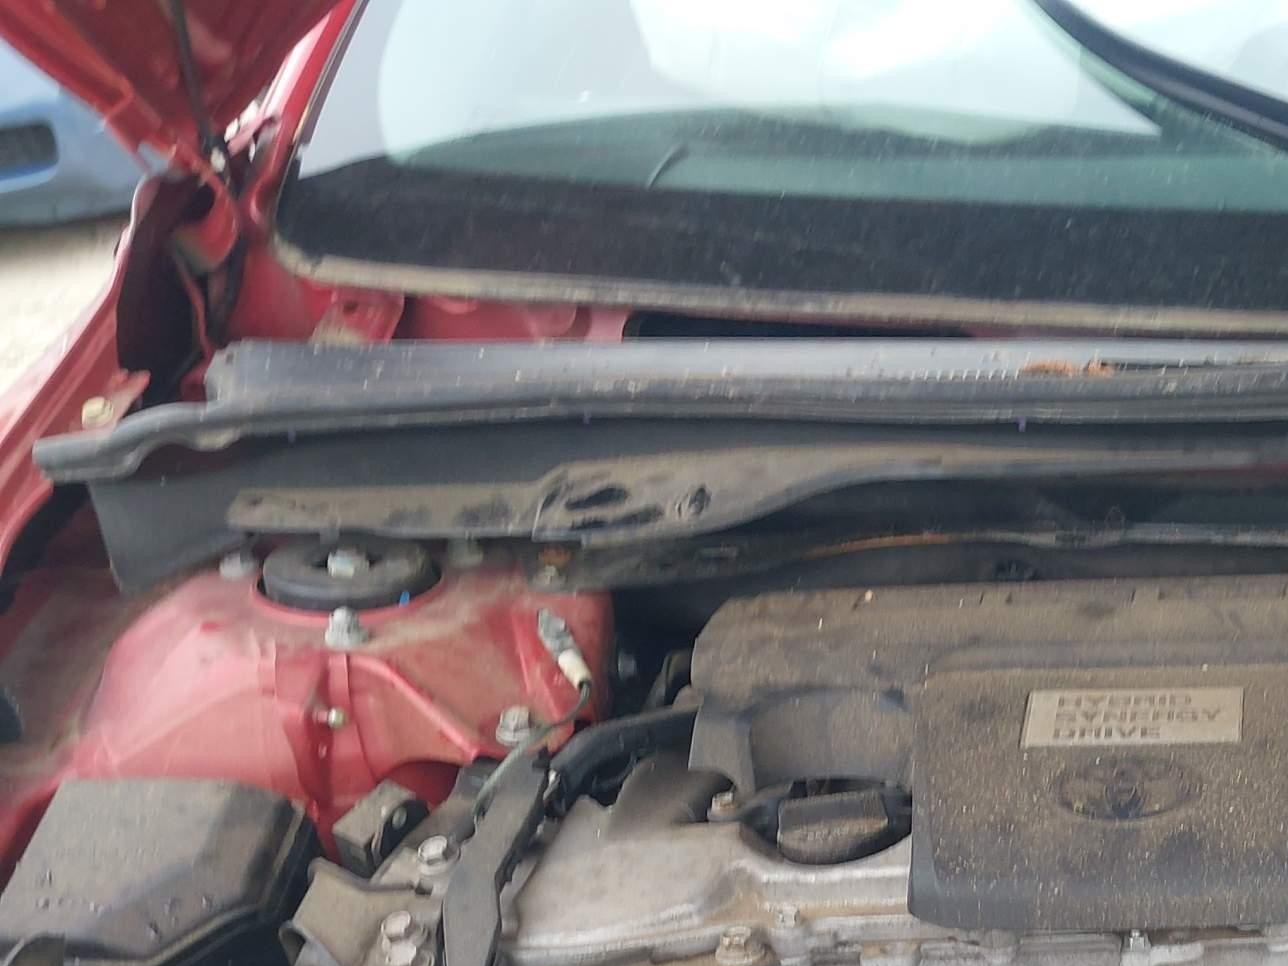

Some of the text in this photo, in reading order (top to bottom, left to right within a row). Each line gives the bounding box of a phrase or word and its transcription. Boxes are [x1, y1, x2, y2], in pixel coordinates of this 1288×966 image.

[1056, 693, 1193, 708] HYBRID
[1055, 708, 1222, 722] SYNERGY
[1053, 726, 1162, 740] DRIVE
